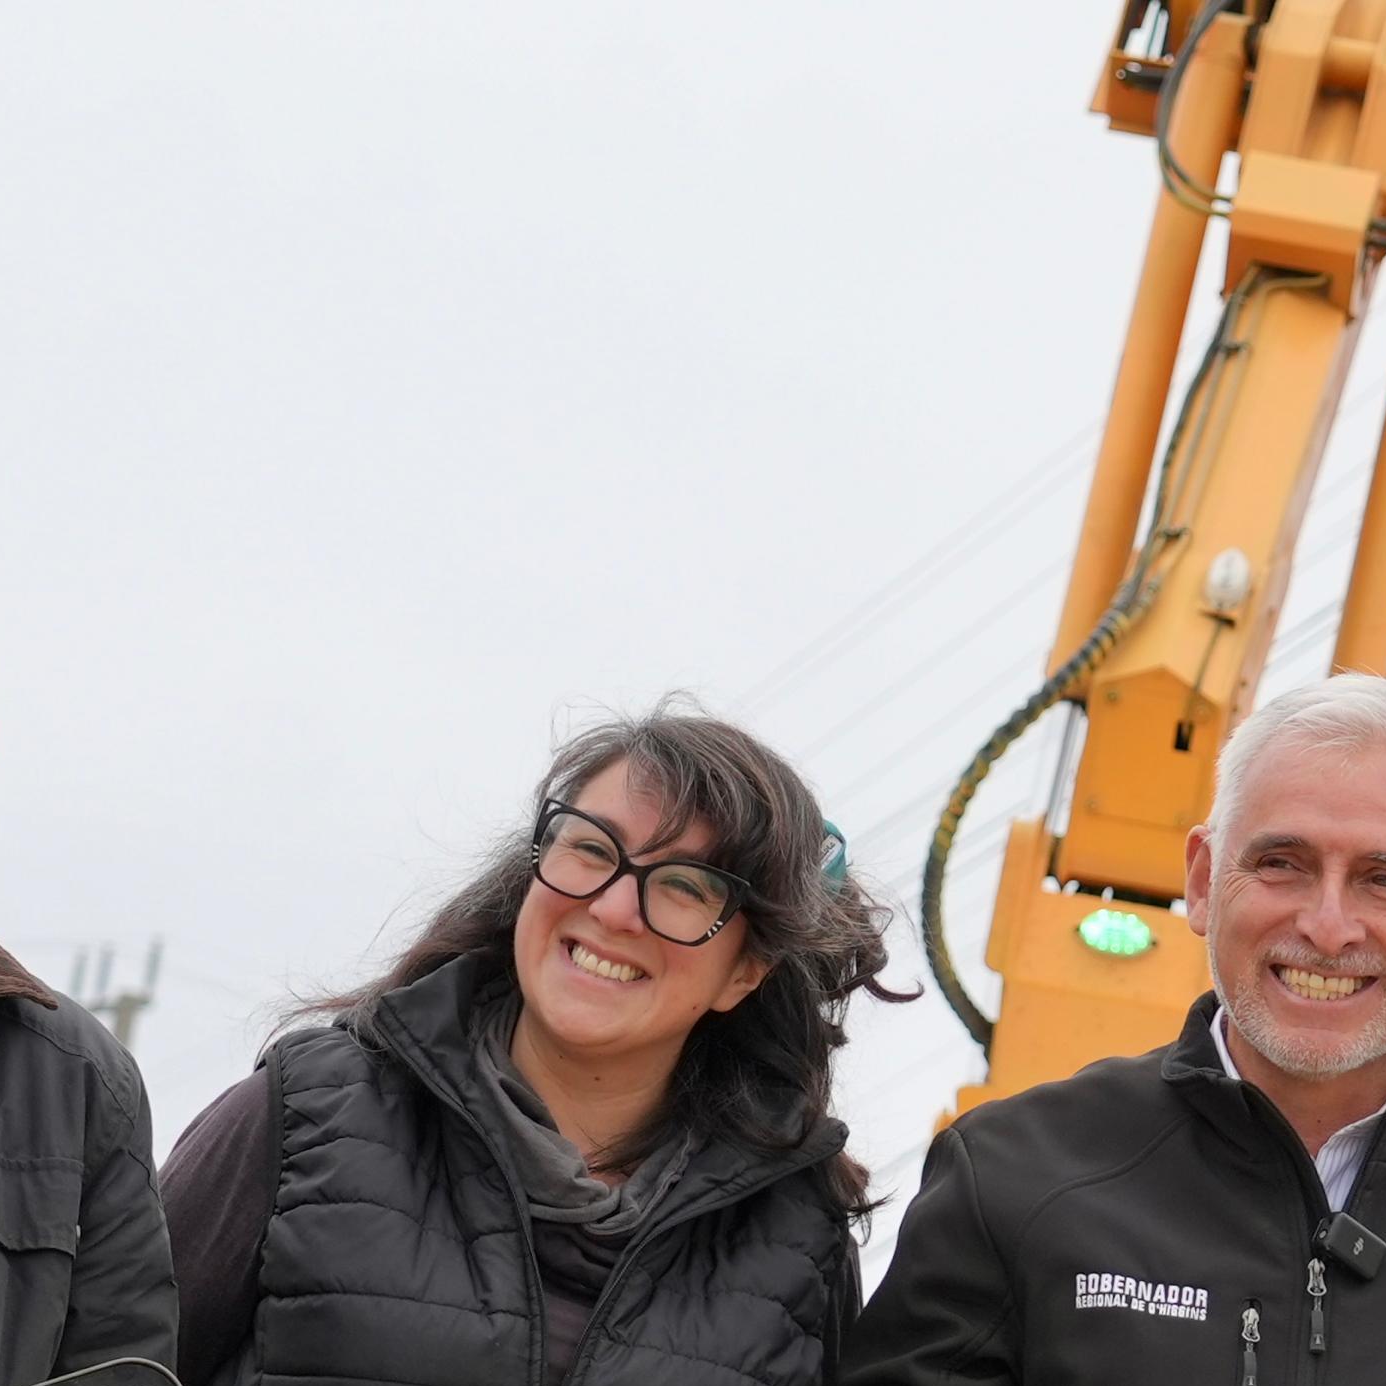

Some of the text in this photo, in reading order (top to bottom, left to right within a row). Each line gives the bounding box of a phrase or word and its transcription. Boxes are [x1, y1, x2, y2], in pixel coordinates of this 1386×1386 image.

[1075, 1272, 1209, 1308] GOBERNADOR
[1075, 1294, 1208, 1321] REGIONAL DE O'HIGGINS
